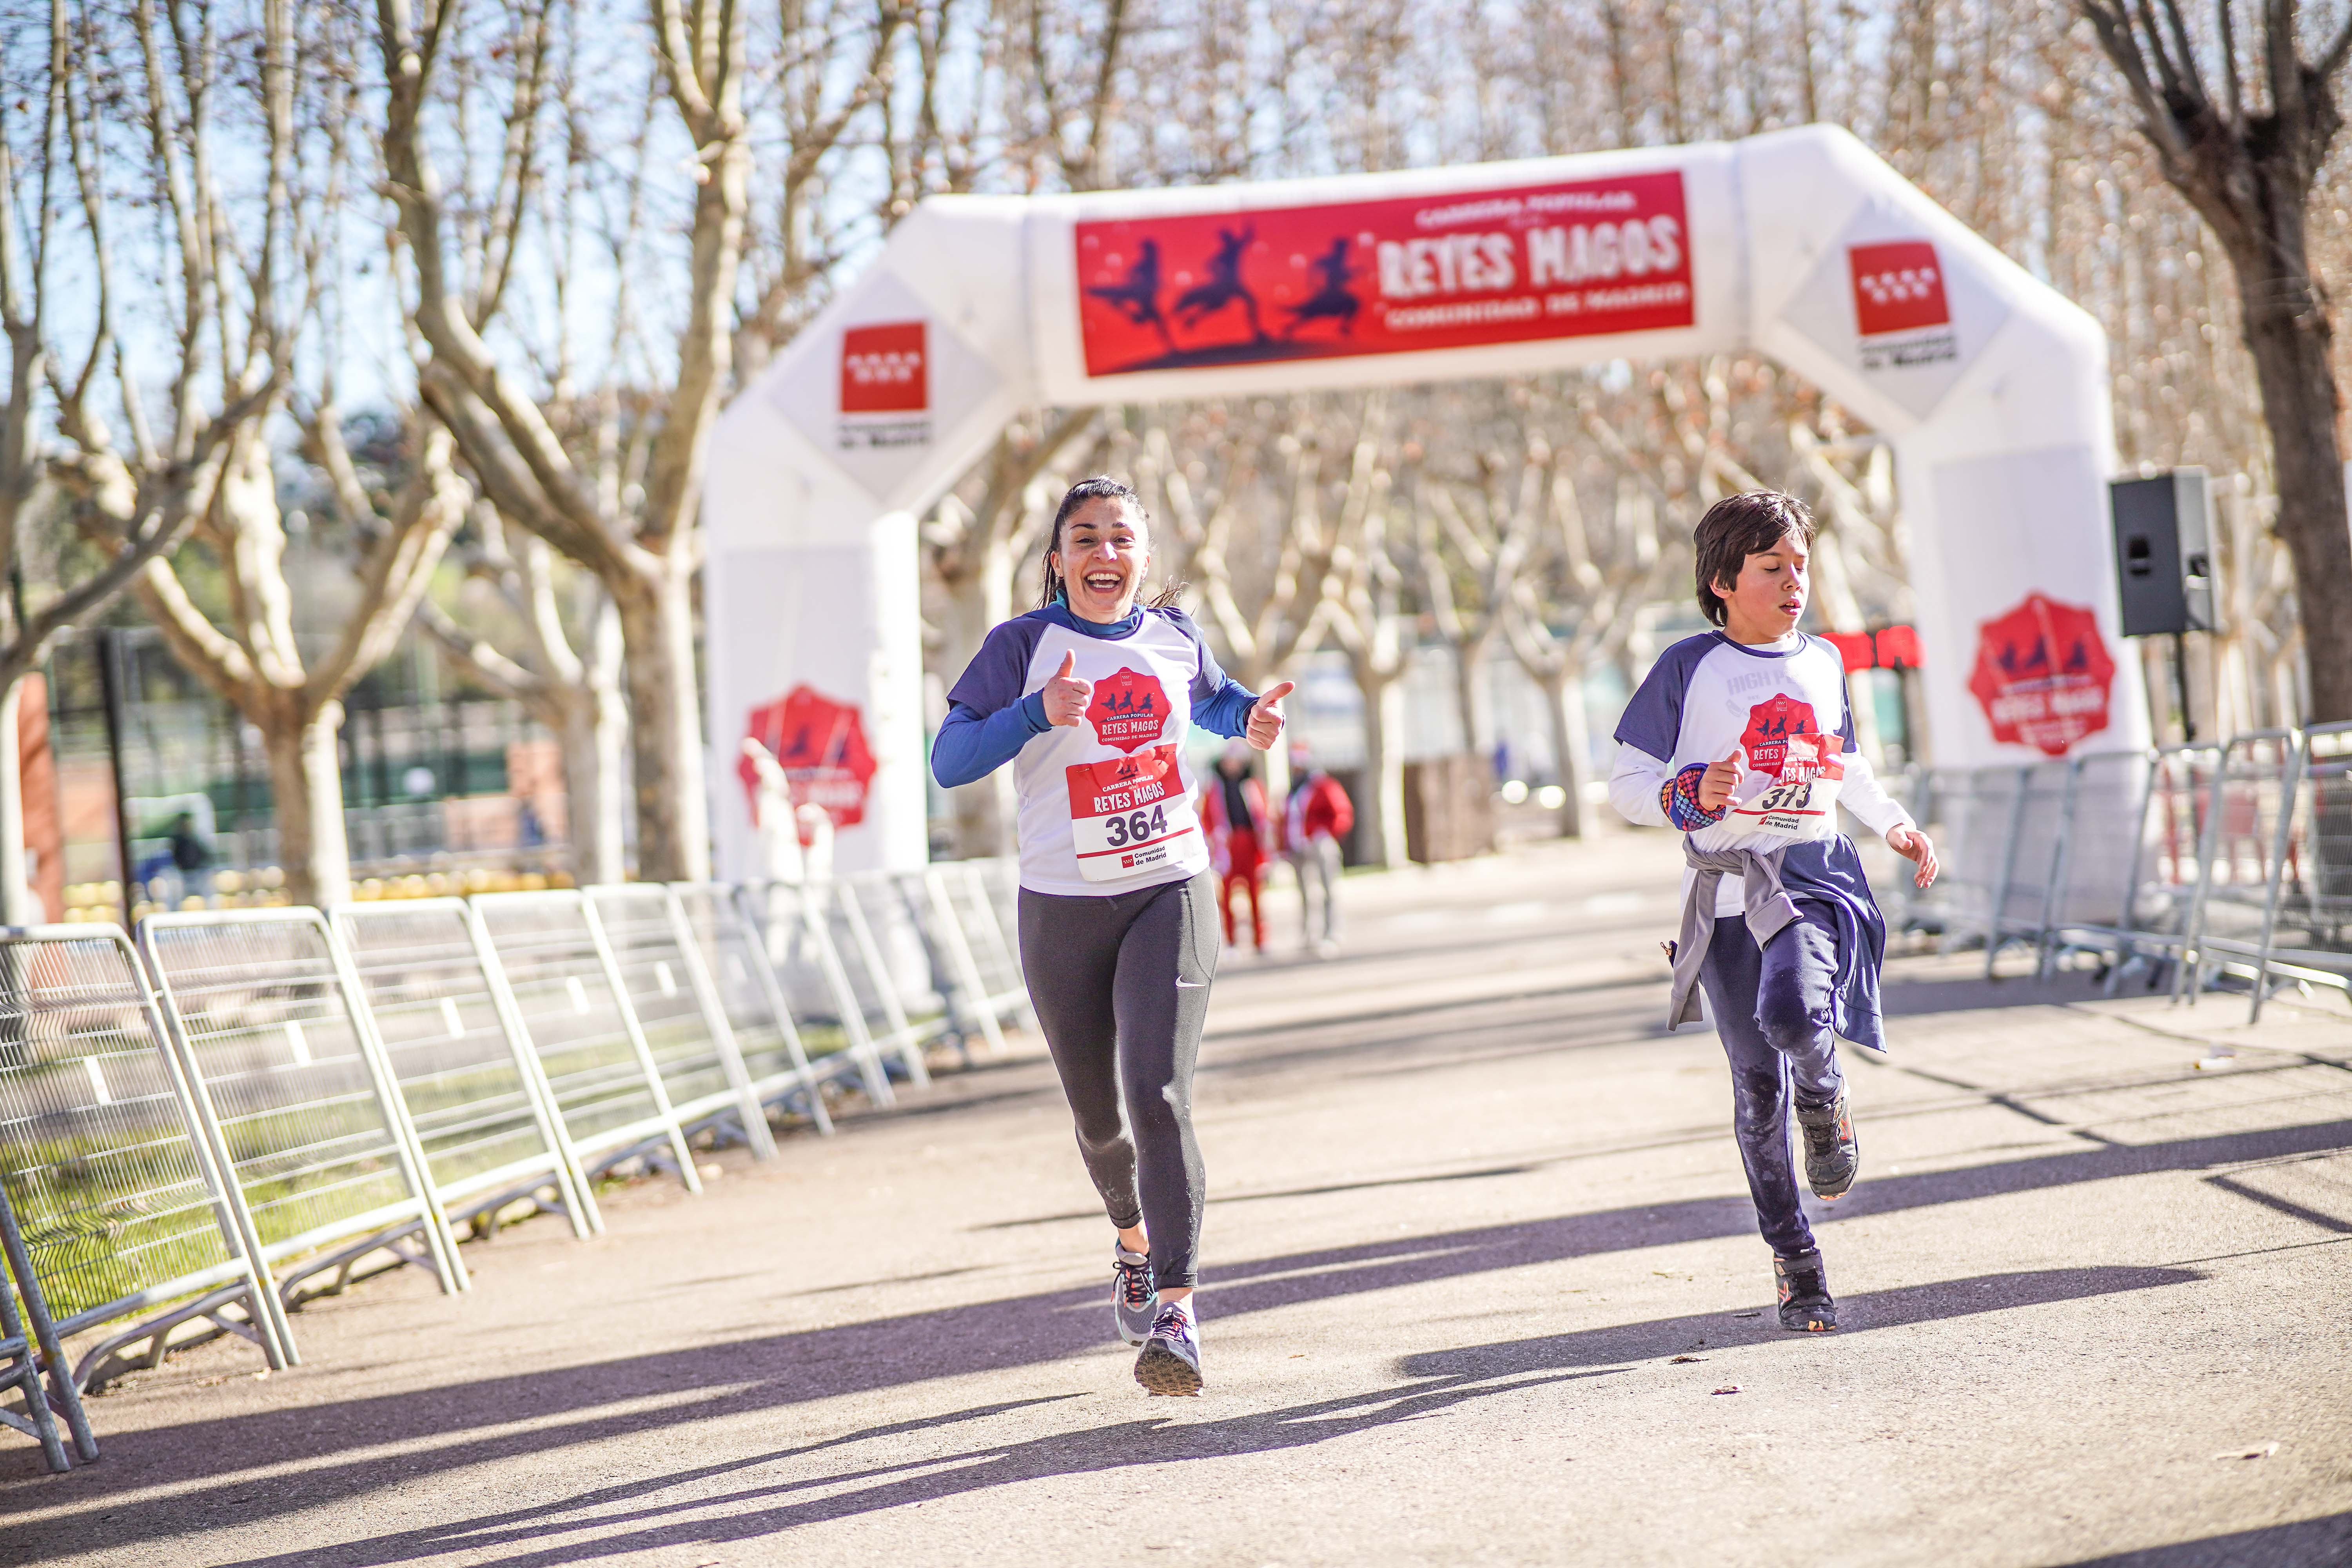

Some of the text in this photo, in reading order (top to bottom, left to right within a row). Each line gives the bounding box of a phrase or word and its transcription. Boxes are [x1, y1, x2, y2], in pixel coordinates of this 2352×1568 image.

[1377, 214, 1683, 299] REYES MAGOS
[1102, 720, 1159, 735] REYES MAGOS
[1754, 748, 1779, 760] REYES
[1779, 766, 1796, 783] YES
[1102, 775, 1154, 792] CARRERA POPULAR
[1094, 781, 1165, 813] REYES MAGOS
[1762, 782, 1811, 809] 313
[1106, 804, 1167, 846] 364
[1134, 846, 1165, 858] Comunidad
[1146, 852, 1167, 863] Madrid
